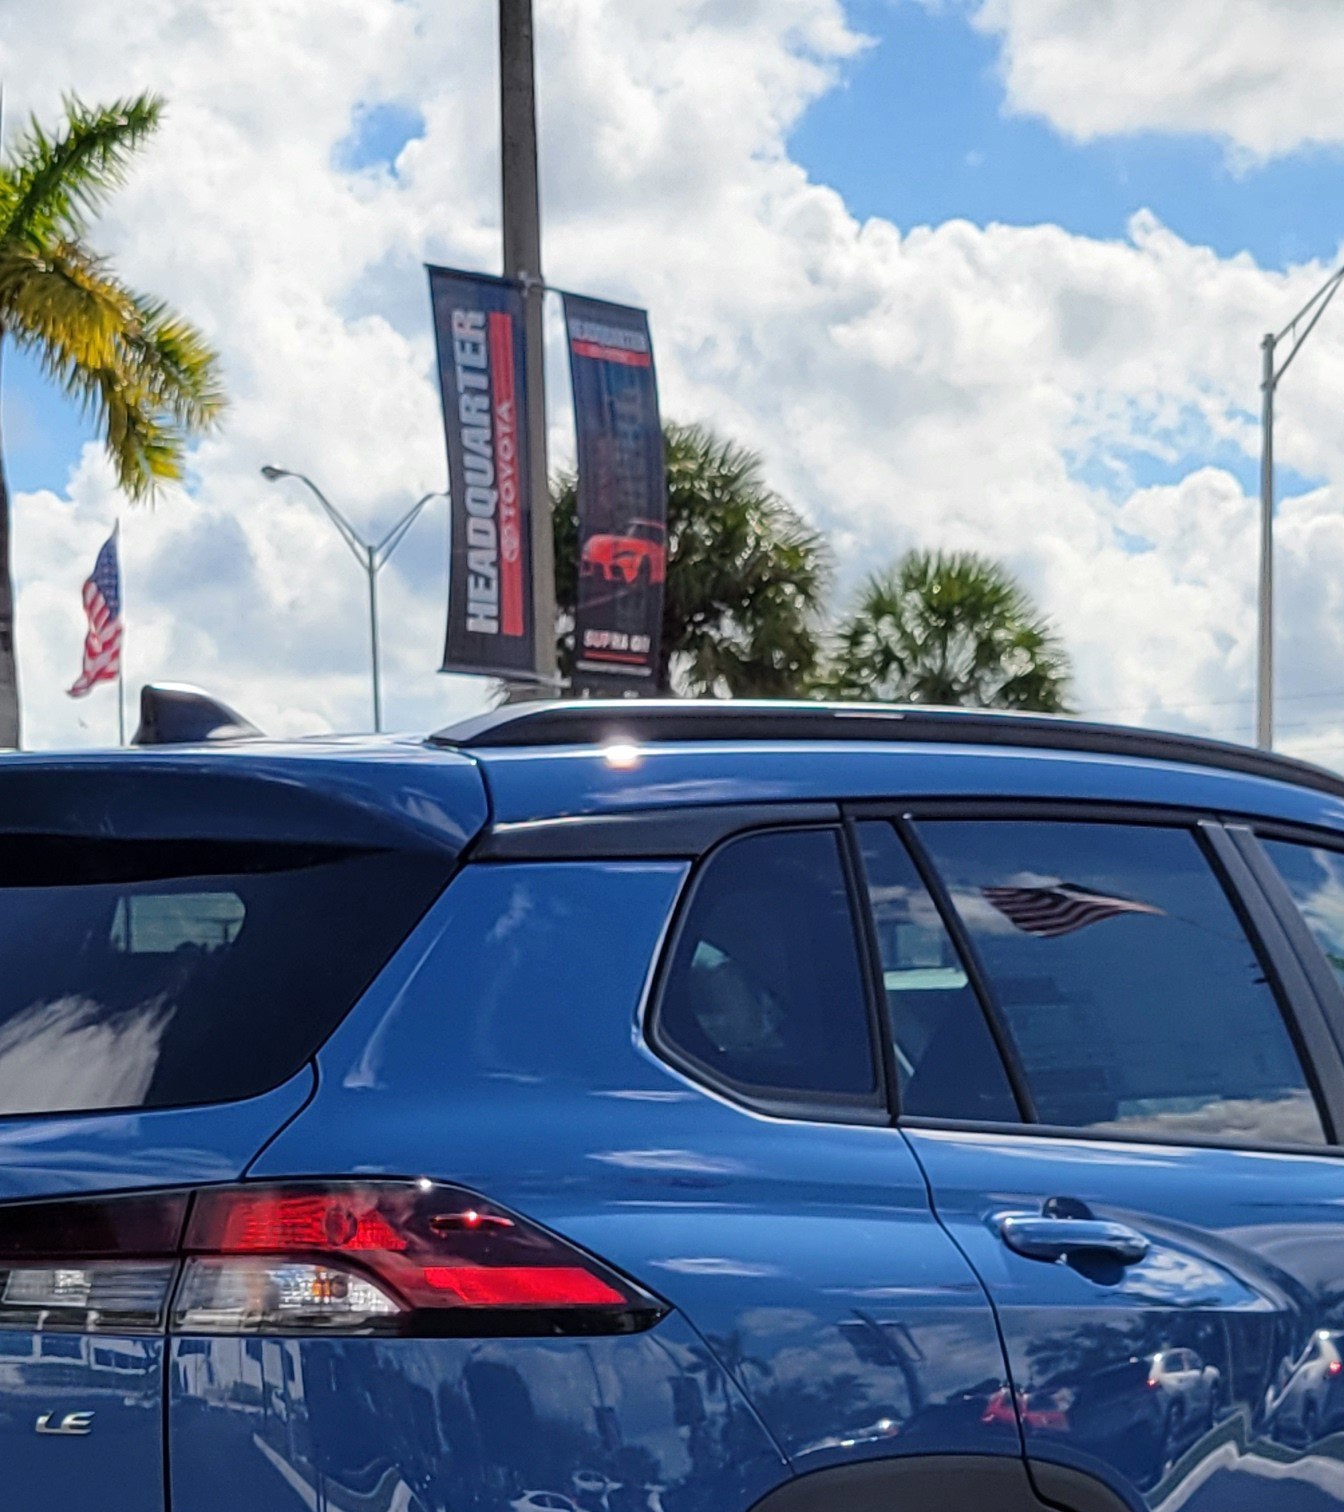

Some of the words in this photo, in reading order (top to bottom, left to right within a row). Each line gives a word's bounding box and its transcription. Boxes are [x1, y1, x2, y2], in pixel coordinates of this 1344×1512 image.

[451, 309, 499, 635] HEADQUARTER
[496, 402, 520, 516] TOYOTA
[35, 1411, 95, 1434] LE
